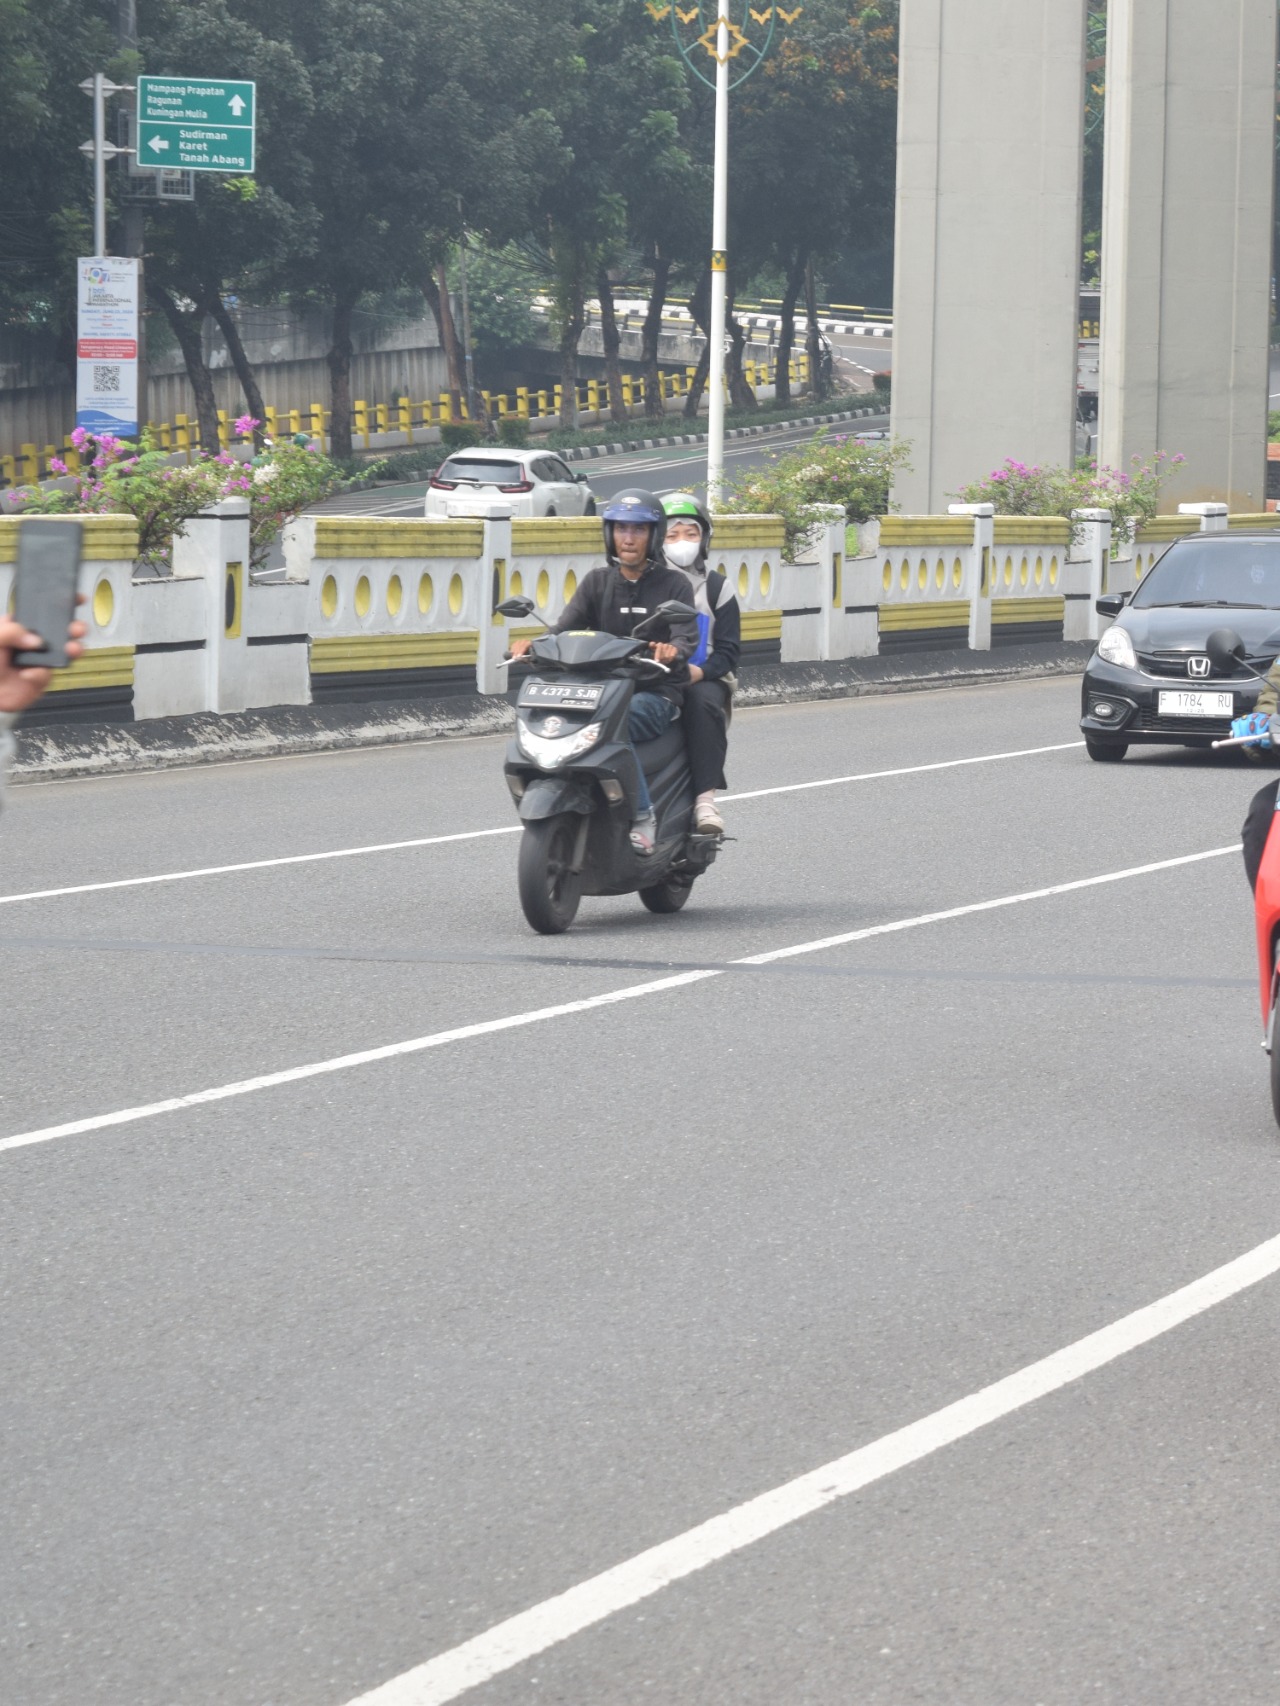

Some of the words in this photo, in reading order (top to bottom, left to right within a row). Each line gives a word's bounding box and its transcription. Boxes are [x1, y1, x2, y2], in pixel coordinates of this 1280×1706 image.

[147, 83, 186, 96] Mampang
[187, 85, 225, 97] Prapatan
[147, 95, 182, 106] Ragunan
[147, 107, 184, 119] Kuningan
[185, 109, 208, 119] Mulia
[180, 129, 228, 140] Sudirman
[179, 141, 208, 151] Karet
[179, 152, 210, 163] Tanah
[211, 154, 245, 167] Abang
[528, 686, 538, 695] B
[541, 687, 571, 697] 4373
[575, 689, 599, 698] SJB
[1160, 692, 1166, 706] F
[1178, 693, 1202, 707] 1784
[1218, 694, 1231, 708] RU
